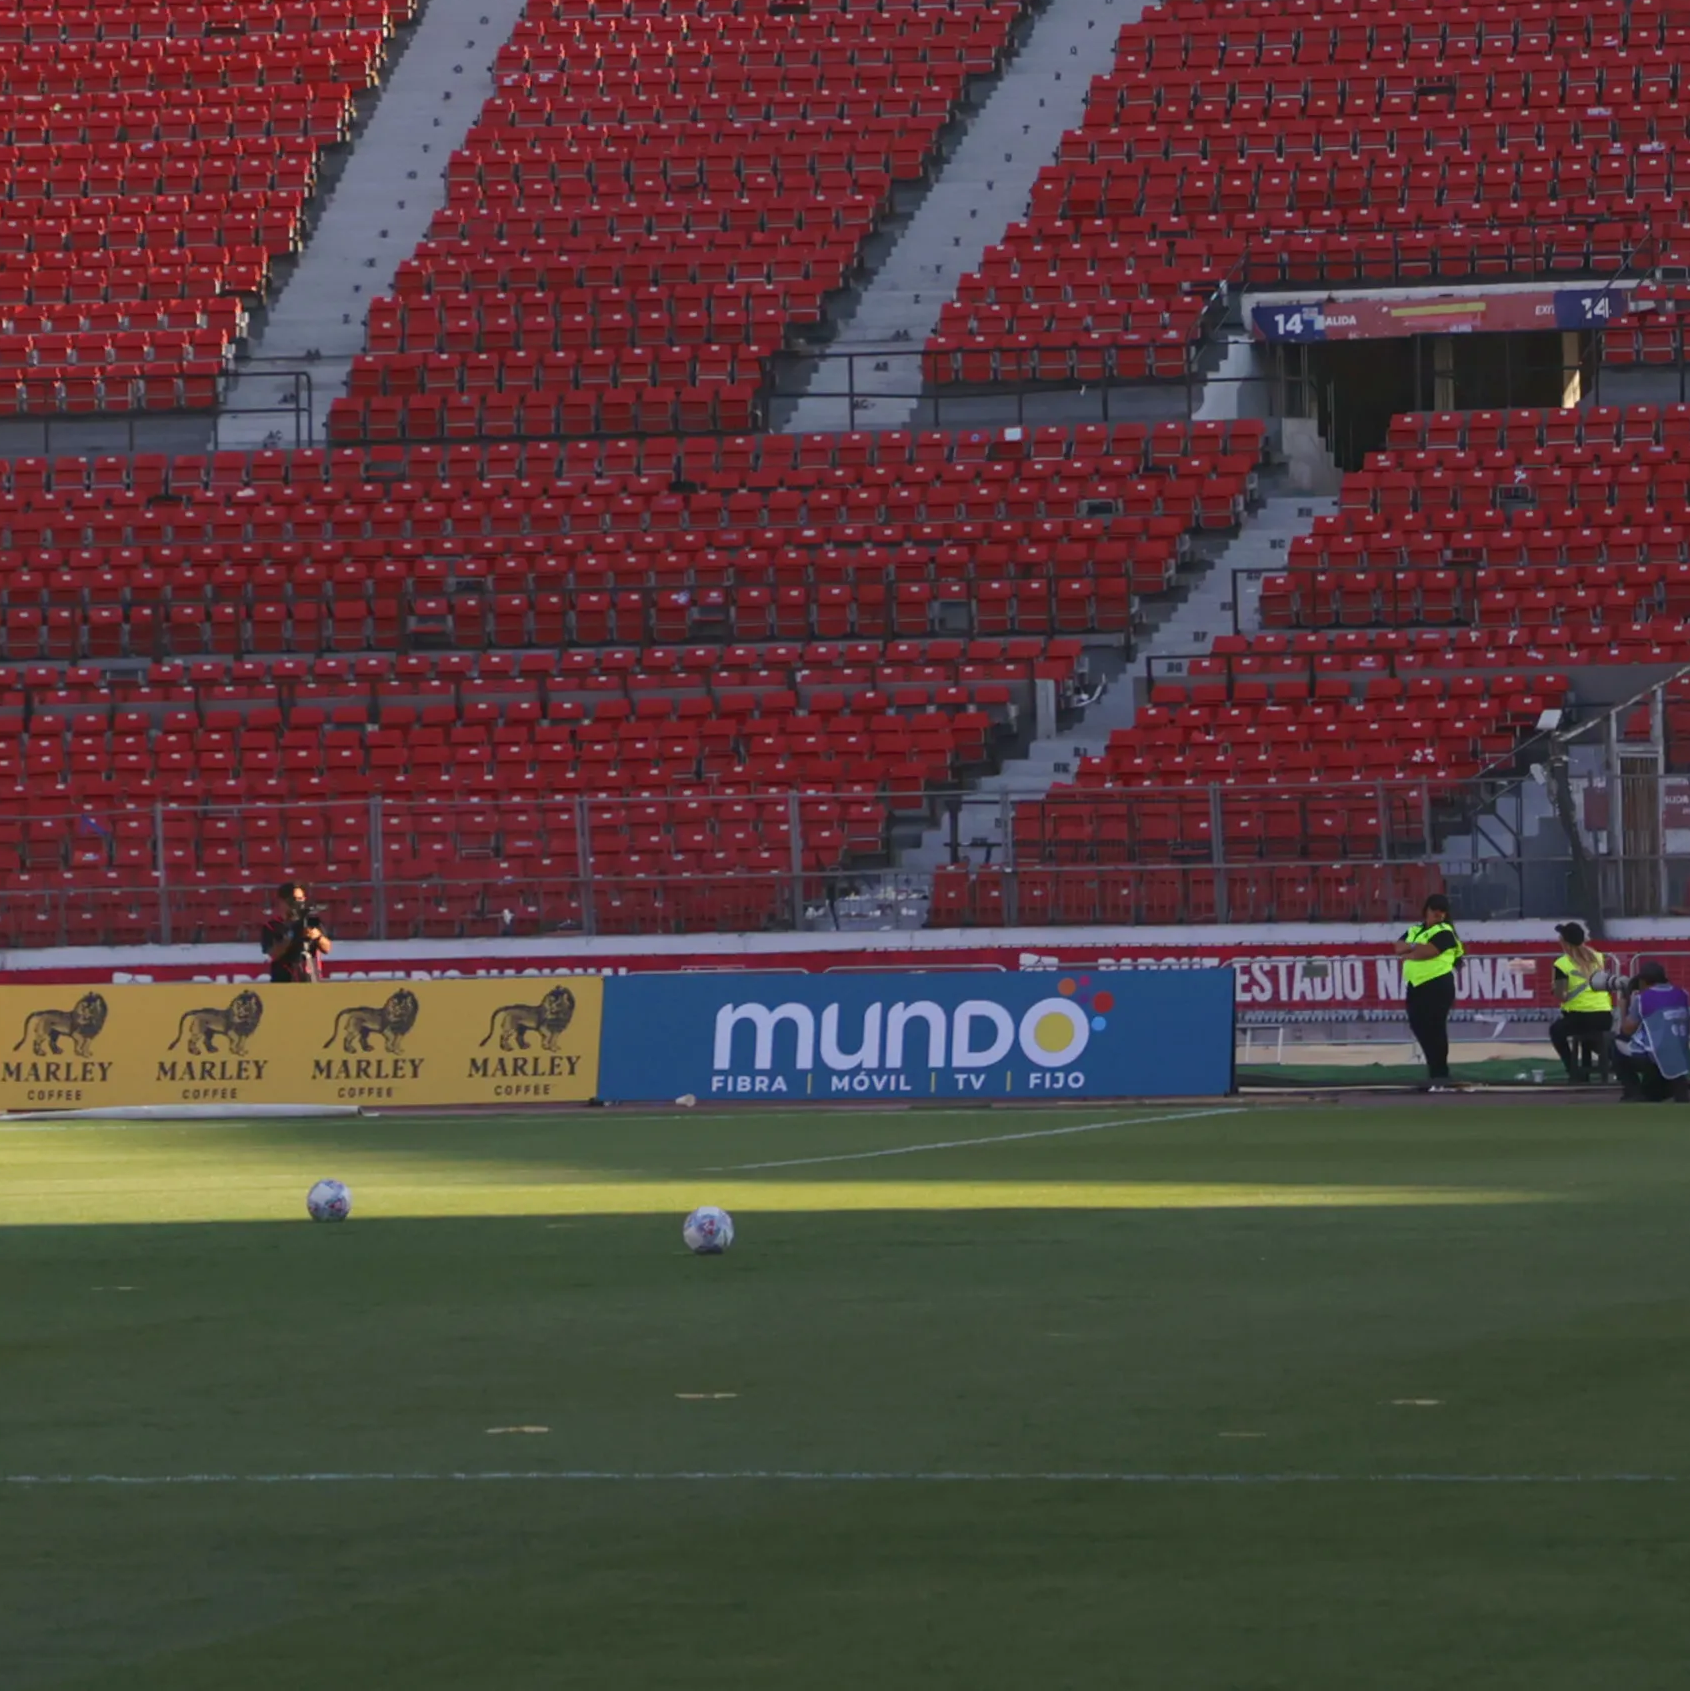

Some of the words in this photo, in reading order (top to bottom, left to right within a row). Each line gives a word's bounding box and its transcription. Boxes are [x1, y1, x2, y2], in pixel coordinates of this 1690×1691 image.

[1274, 312, 1304, 335] 14
[1235, 956, 1363, 1002] ESTADIO
[1, 1061, 113, 1082] MARLEY
[156, 1060, 268, 1081] MARLEY
[311, 1058, 424, 1079] MARLEY
[466, 1056, 581, 1078] MARLEY
[337, 1086, 393, 1098] COFFEE
[494, 1084, 550, 1096] COFFEE
[711, 1075, 788, 1092] FIBRA
[831, 1071, 912, 1092] MÓVIL
[954, 1074, 986, 1090] TV
[1029, 1072, 1085, 1089] FIJO
[27, 1089, 82, 1101] COFFEE
[182, 1088, 237, 1099] COFFEE
